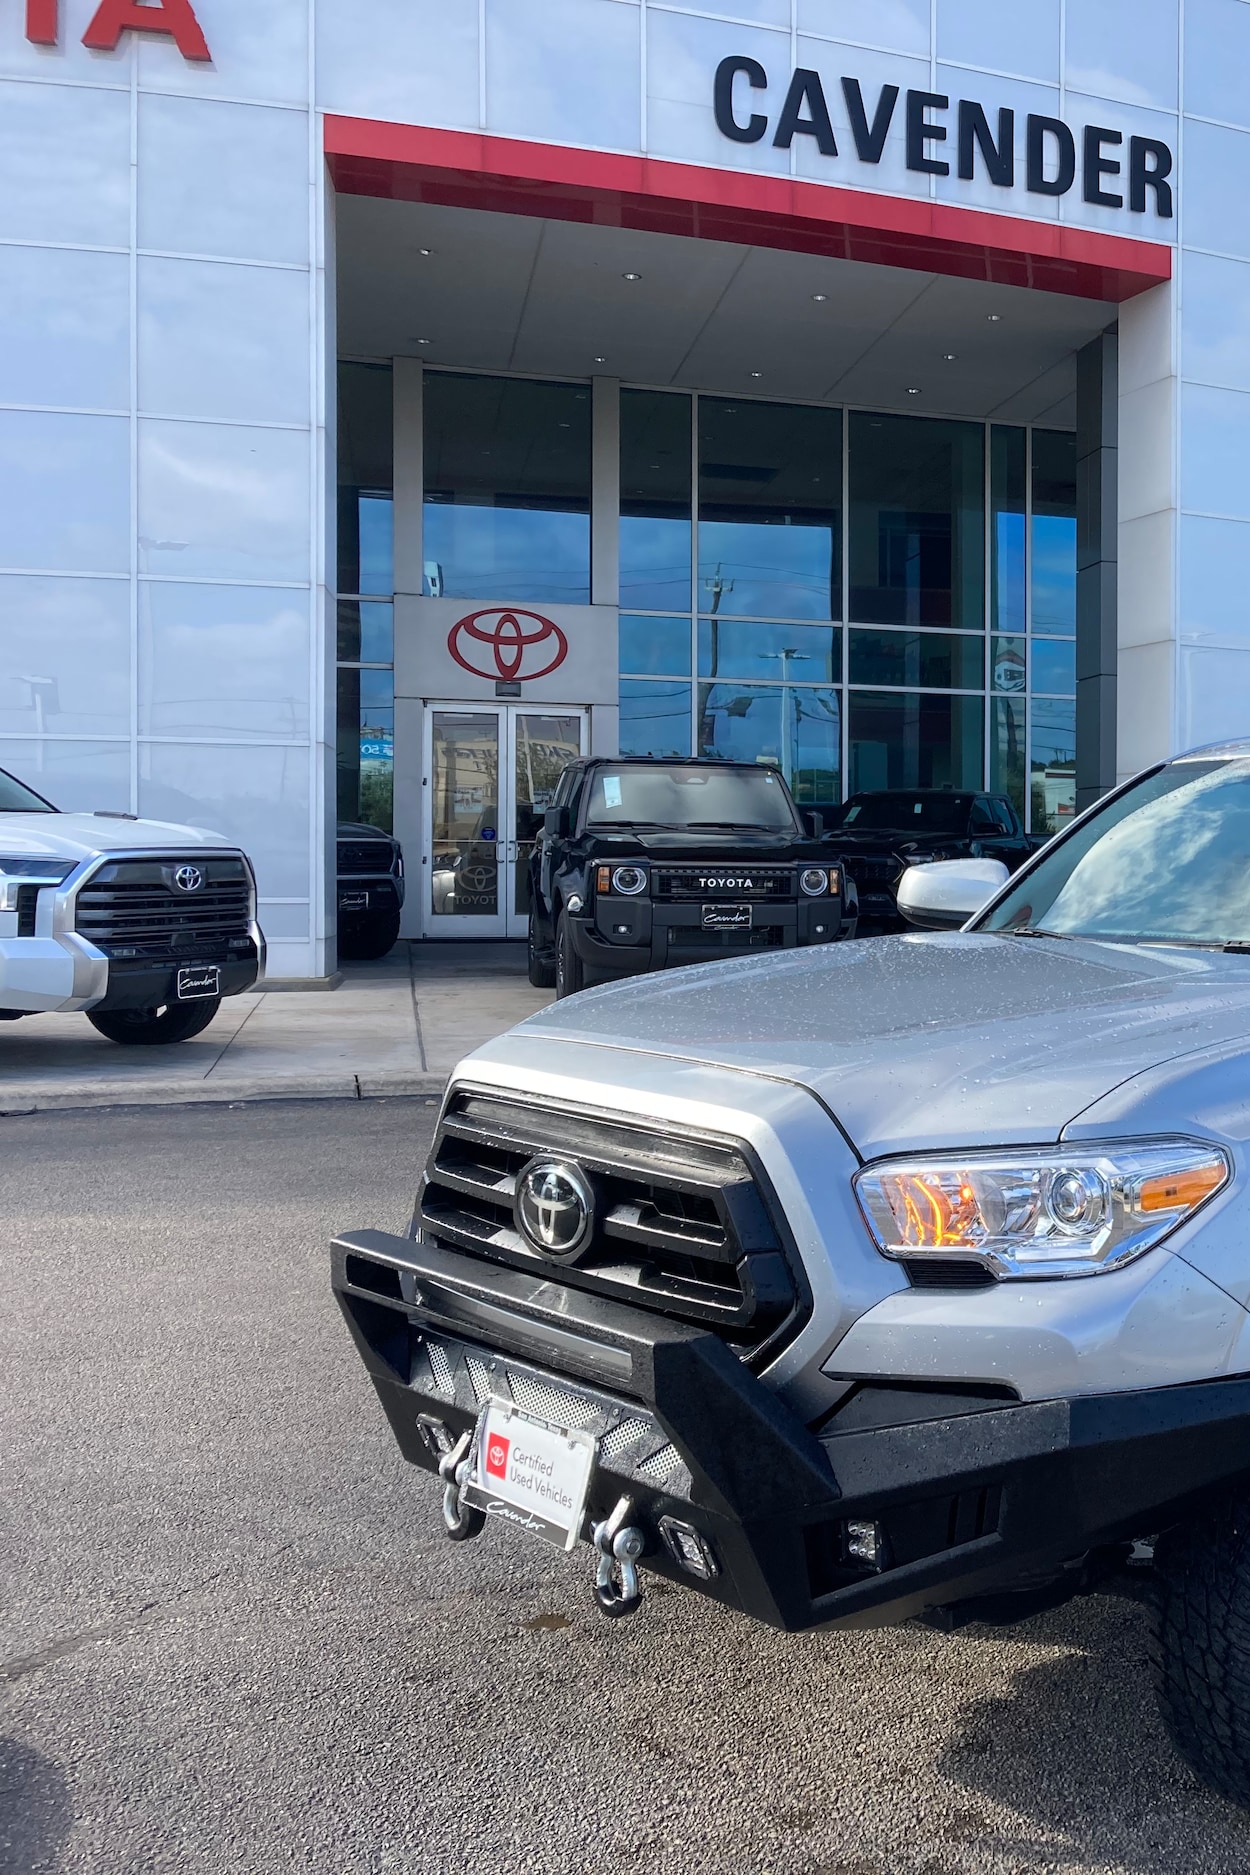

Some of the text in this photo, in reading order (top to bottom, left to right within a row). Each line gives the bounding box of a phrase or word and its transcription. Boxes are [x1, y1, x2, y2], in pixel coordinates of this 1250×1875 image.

[714, 55, 1173, 218] CAVENDER
[698, 878, 754, 888] TOYOTA
[512, 1446, 554, 1477] Certified
[510, 1466, 573, 1510] Used Vehicles
[486, 1501, 546, 1531] Cavender
